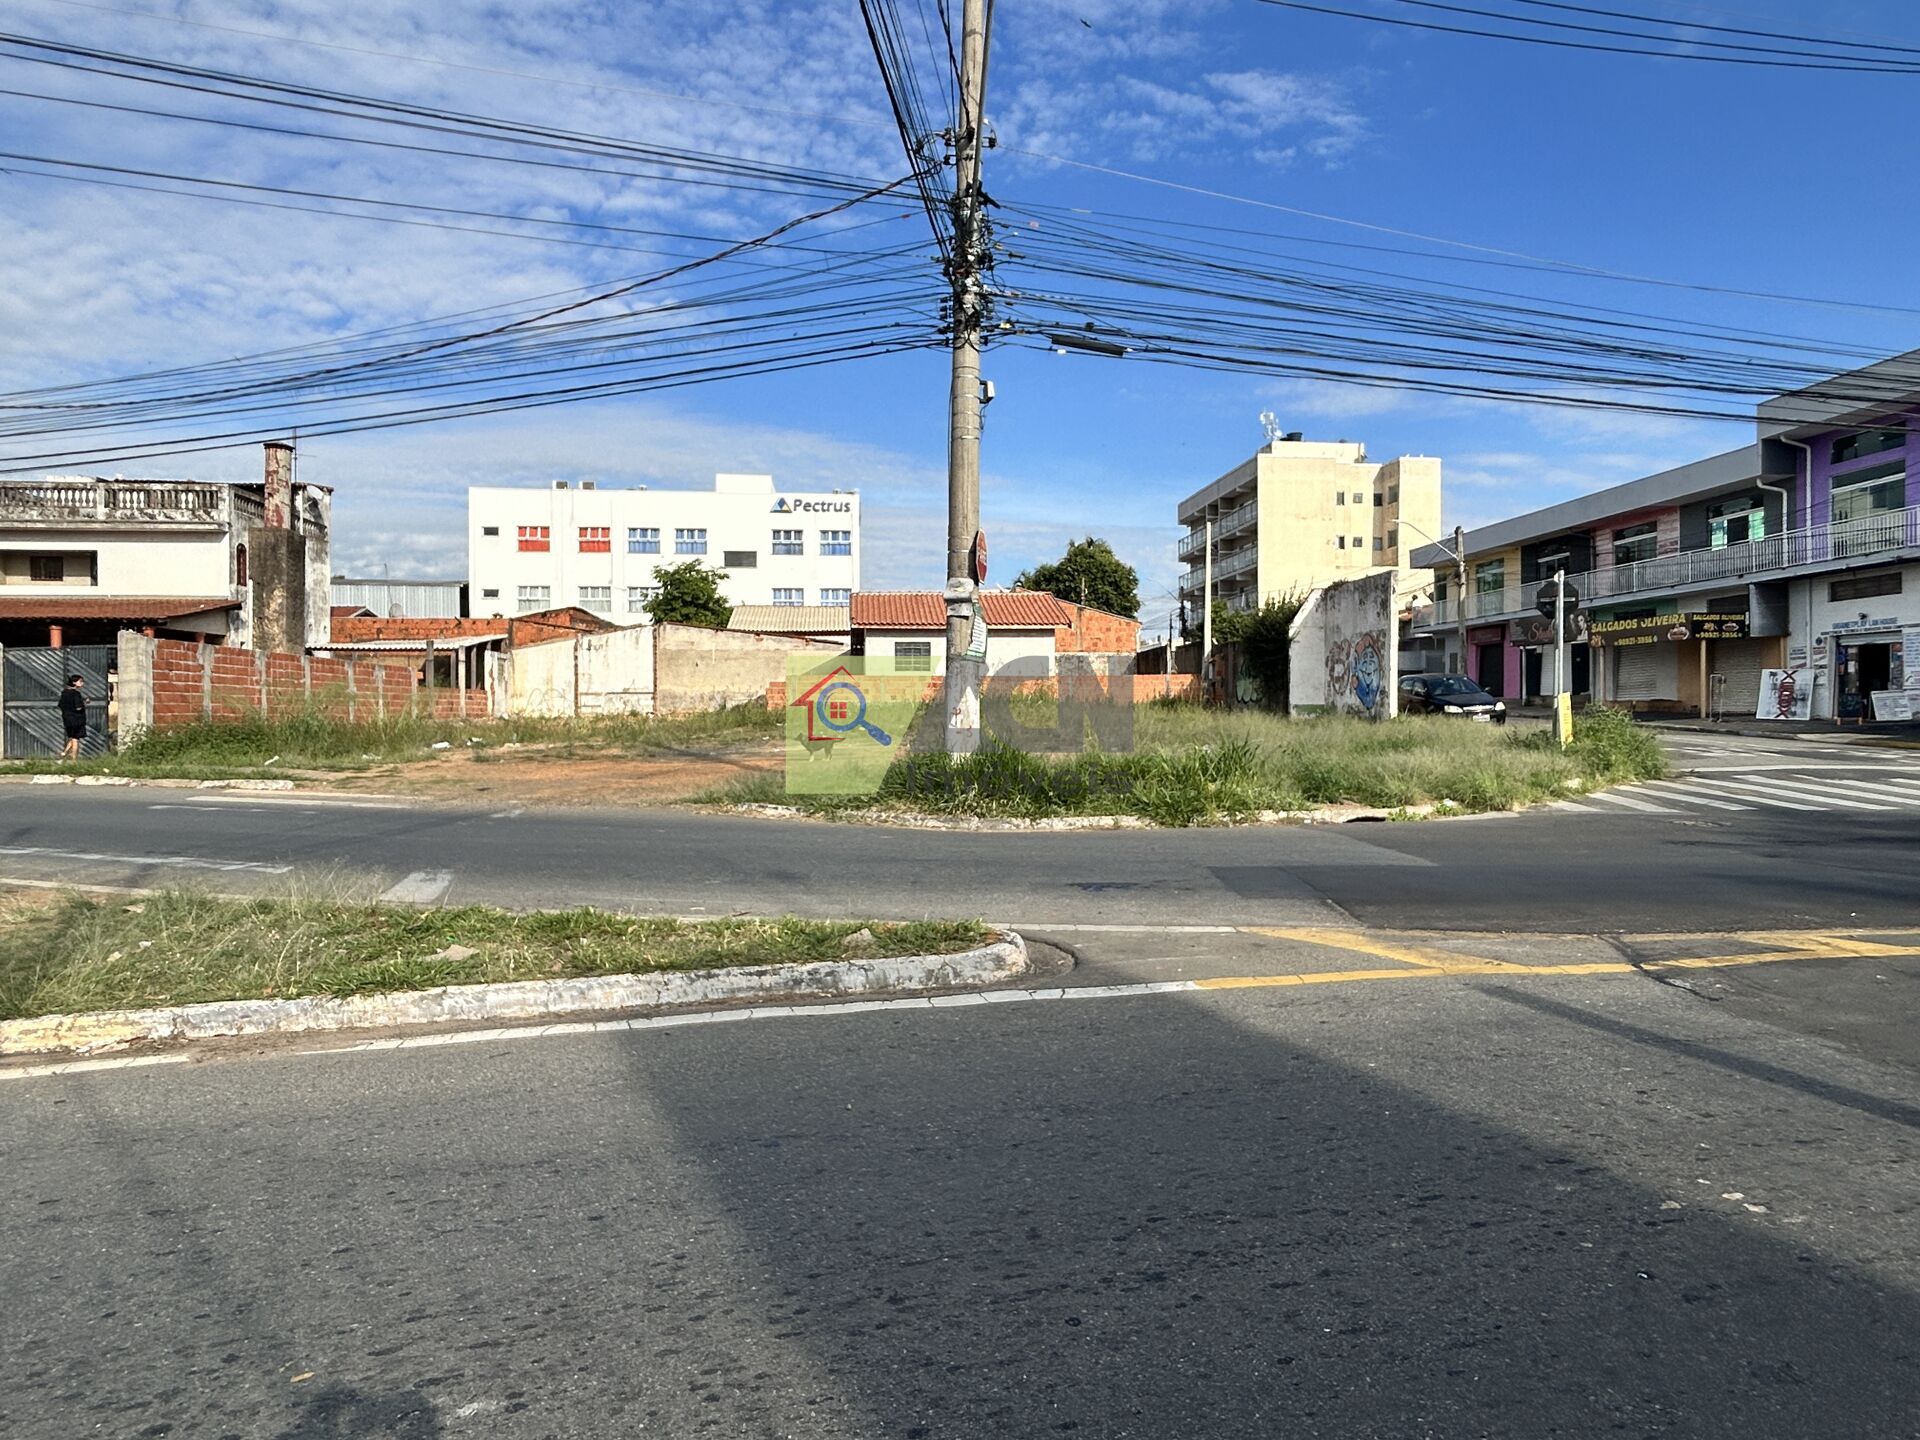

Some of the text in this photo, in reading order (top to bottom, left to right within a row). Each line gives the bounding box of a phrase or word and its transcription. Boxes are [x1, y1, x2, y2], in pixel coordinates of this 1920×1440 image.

[793, 498, 851, 513] Pectrus
[1590, 612, 1687, 633] SALGADOS OLIVEIRA
